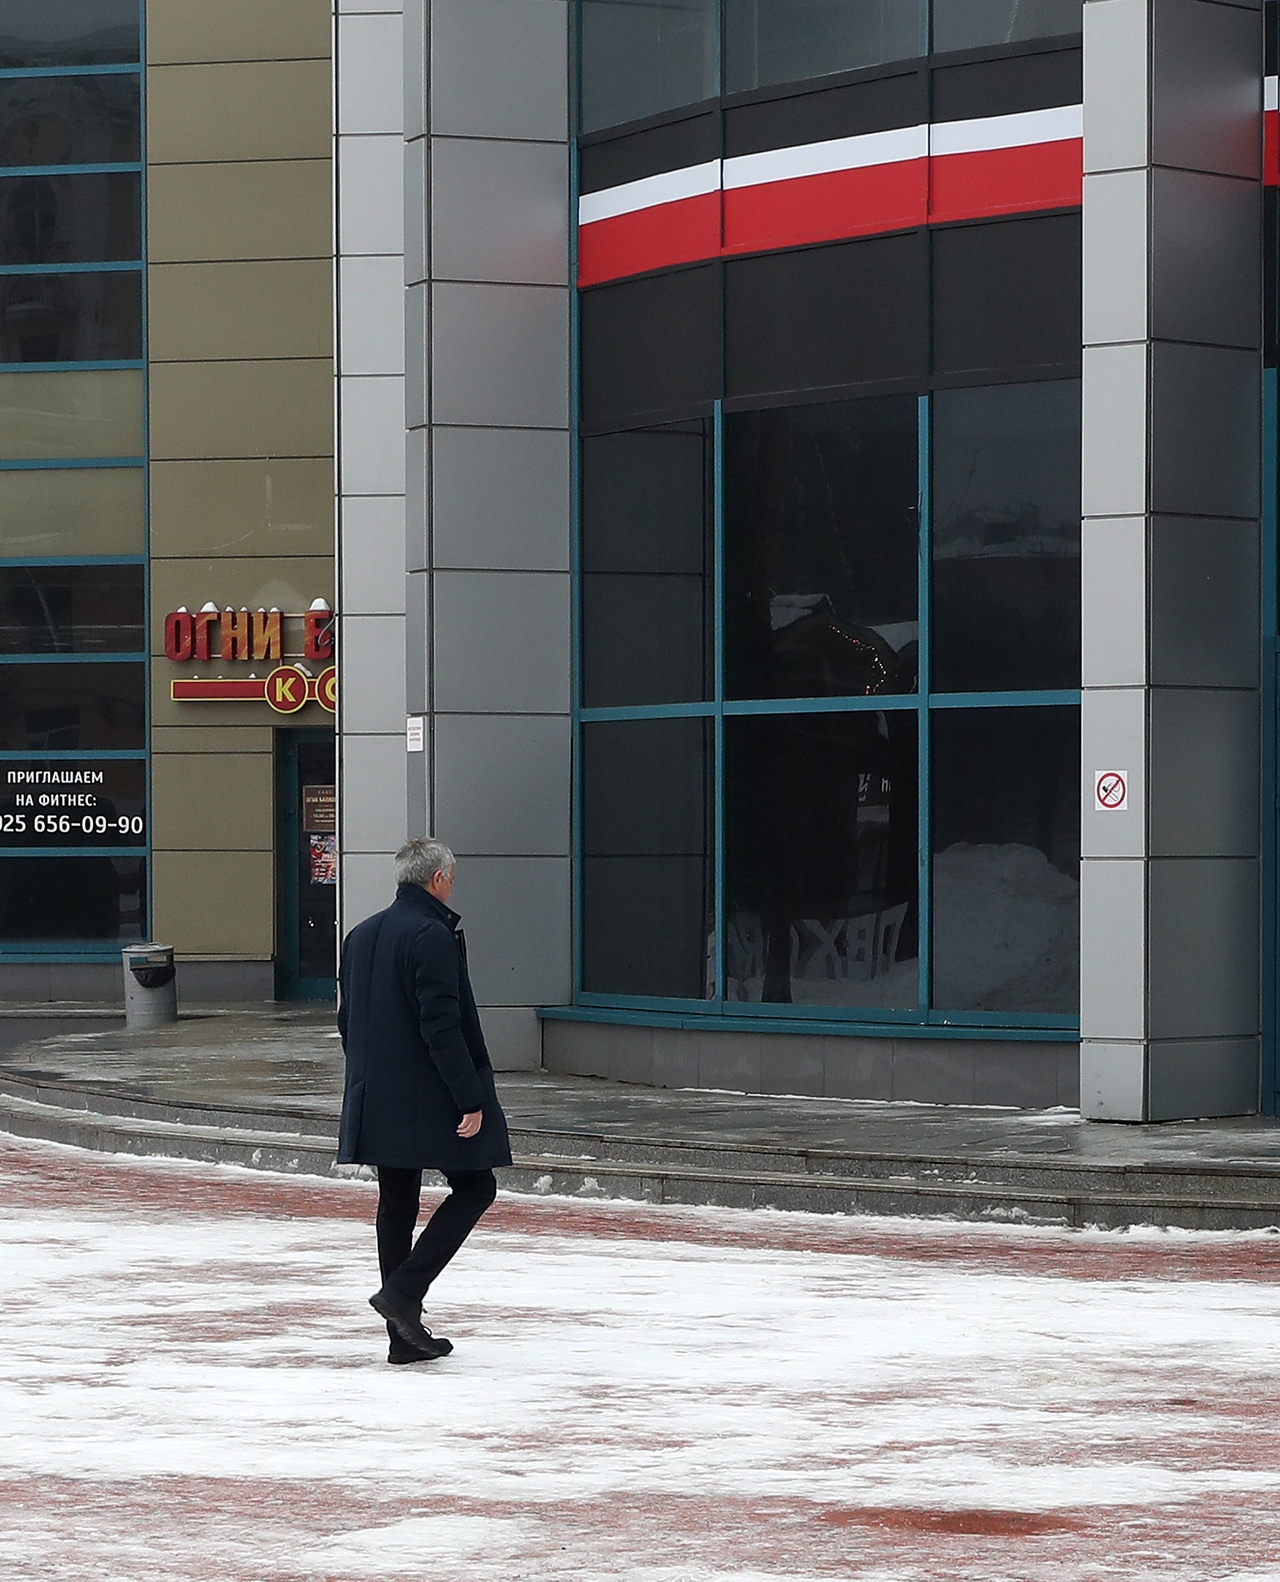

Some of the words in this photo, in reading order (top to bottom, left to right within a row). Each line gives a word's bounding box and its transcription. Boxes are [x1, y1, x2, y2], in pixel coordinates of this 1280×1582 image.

[165, 612, 284, 661] ОГНИ
[7, 770, 104, 784] ПРИГЛАШАЕМ
[15, 793, 34, 807] НА
[38, 793, 97, 807] ФИТНЕС:
[0, 814, 26, 833] 25
[34, 814, 143, 834] 656-09-90
